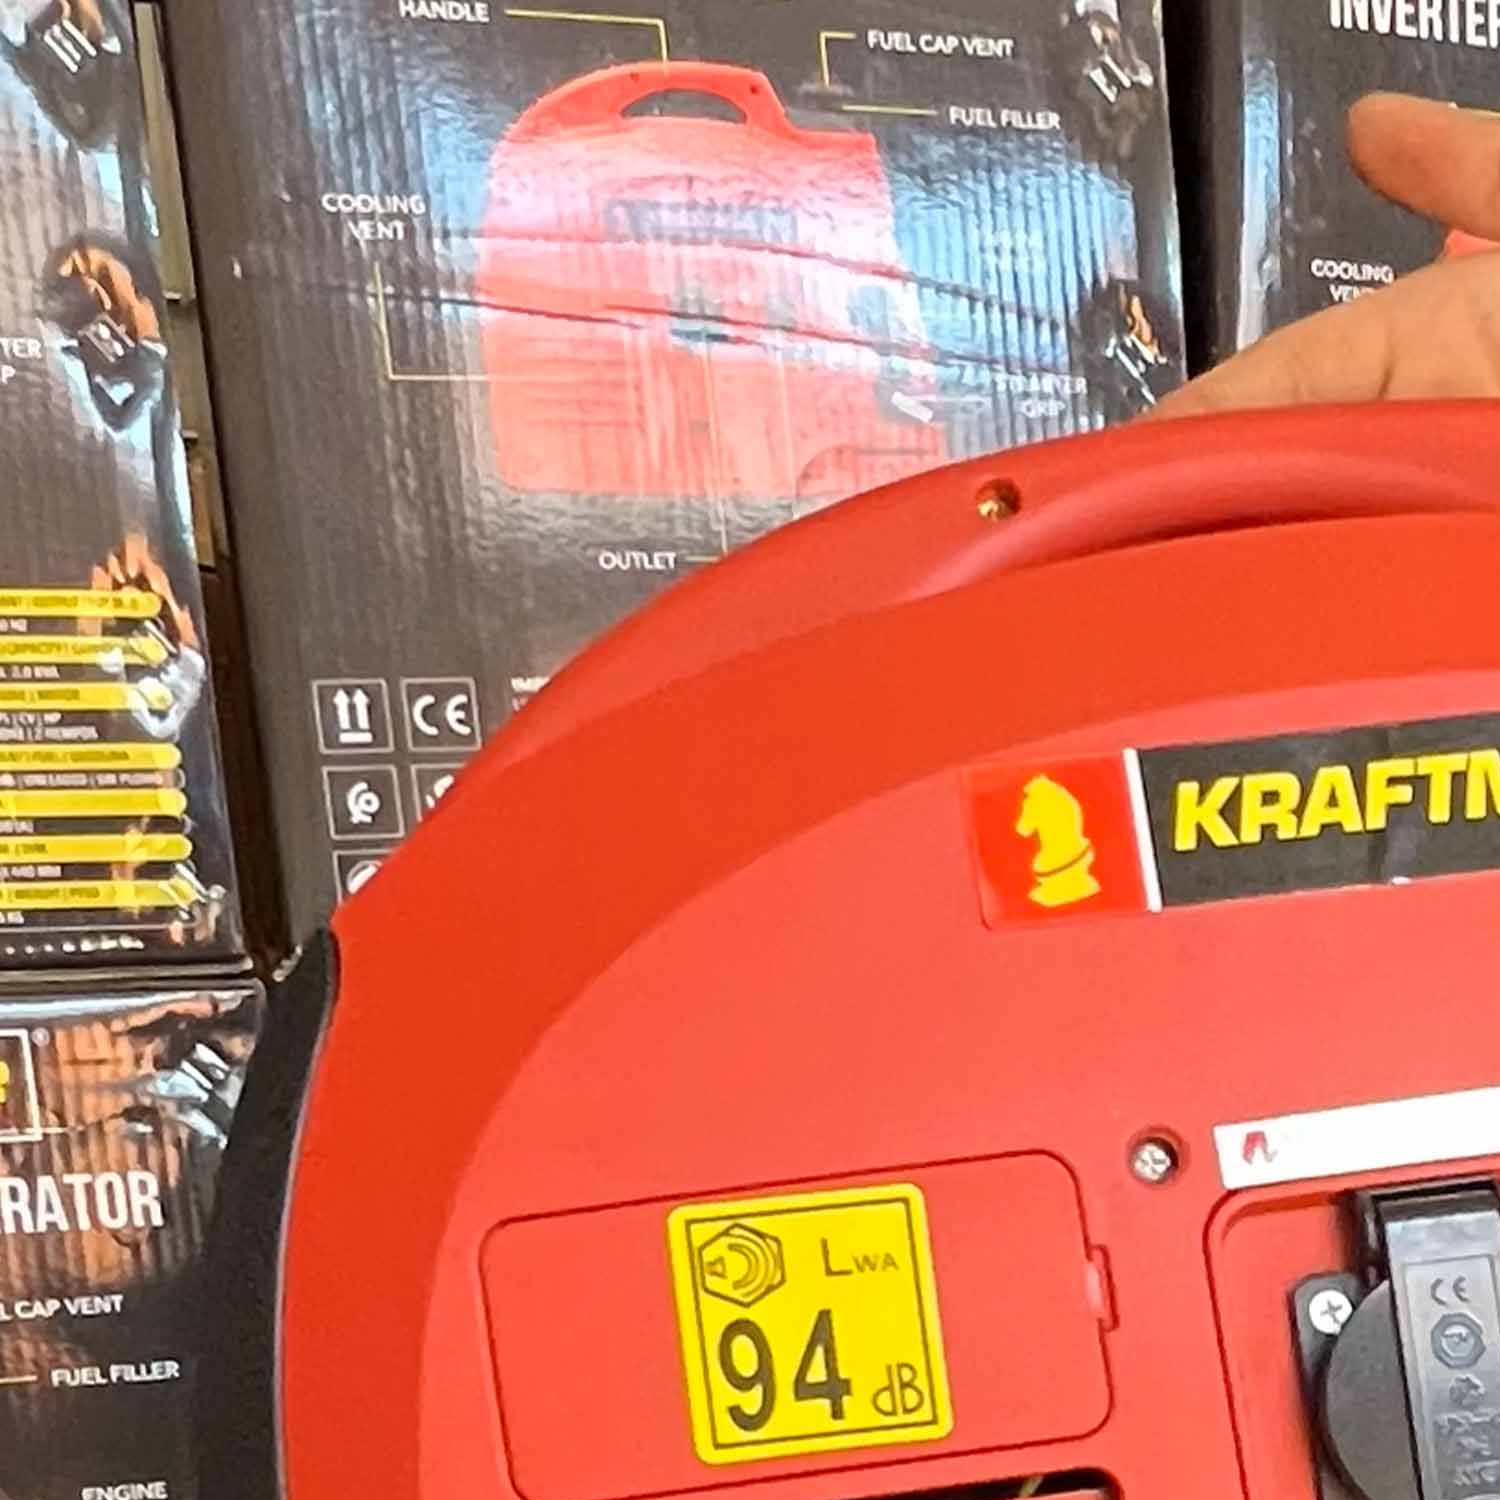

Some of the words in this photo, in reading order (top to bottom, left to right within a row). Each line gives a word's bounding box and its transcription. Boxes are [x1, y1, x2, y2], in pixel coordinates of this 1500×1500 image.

[400, 1, 489, 23] HANDLE
[867, 30, 918, 53] FUEL
[922, 34, 958, 56] CAP
[960, 36, 1014, 58] VENT
[949, 106, 996, 128] FUEL
[1000, 108, 1061, 131] FILLER
[321, 193, 426, 215] COOLING
[347, 219, 405, 240] VENT
[1311, 259, 1393, 284] COOLING
[600, 551, 677, 571] OUTLET
[14, 1299, 62, 1320] CAP
[63, 1294, 124, 1317] VENT
[51, 1366, 108, 1388] FUEL
[110, 1360, 180, 1382] FILLER
[717, 1308, 853, 1433] 94
[871, 1362, 925, 1418] dB
